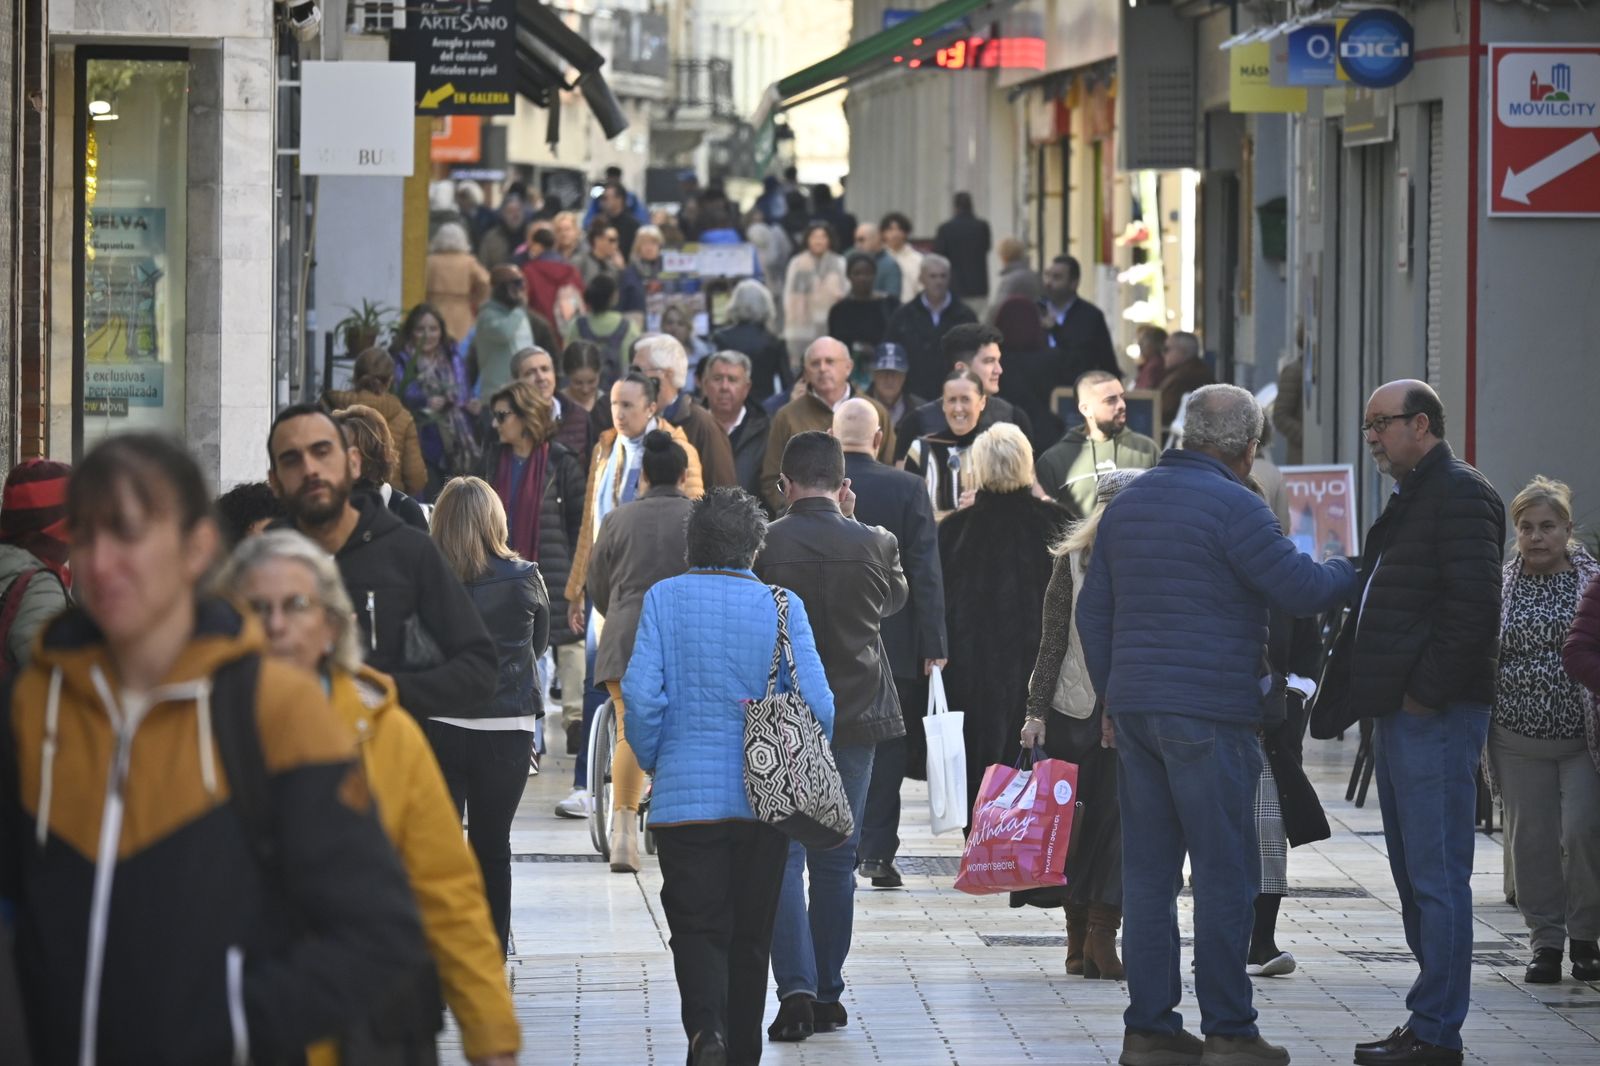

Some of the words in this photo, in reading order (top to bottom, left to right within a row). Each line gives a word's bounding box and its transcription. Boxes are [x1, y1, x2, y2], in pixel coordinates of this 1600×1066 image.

[420, 13, 508, 32] ARTESANO
[432, 37, 463, 50] Arreglo
[472, 38, 496, 48] venta
[1340, 42, 1409, 57] DIGI
[440, 51, 453, 61] del
[455, 51, 488, 61] calzado
[468, 67, 479, 75] en
[481, 64, 498, 76] piel
[454, 92, 467, 104] EN
[1509, 102, 1596, 116] MOVILCITY
[93, 370, 146, 382] exclusivas
[88, 386, 158, 398] personalizada
[966, 860, 1016, 873] women'secret
